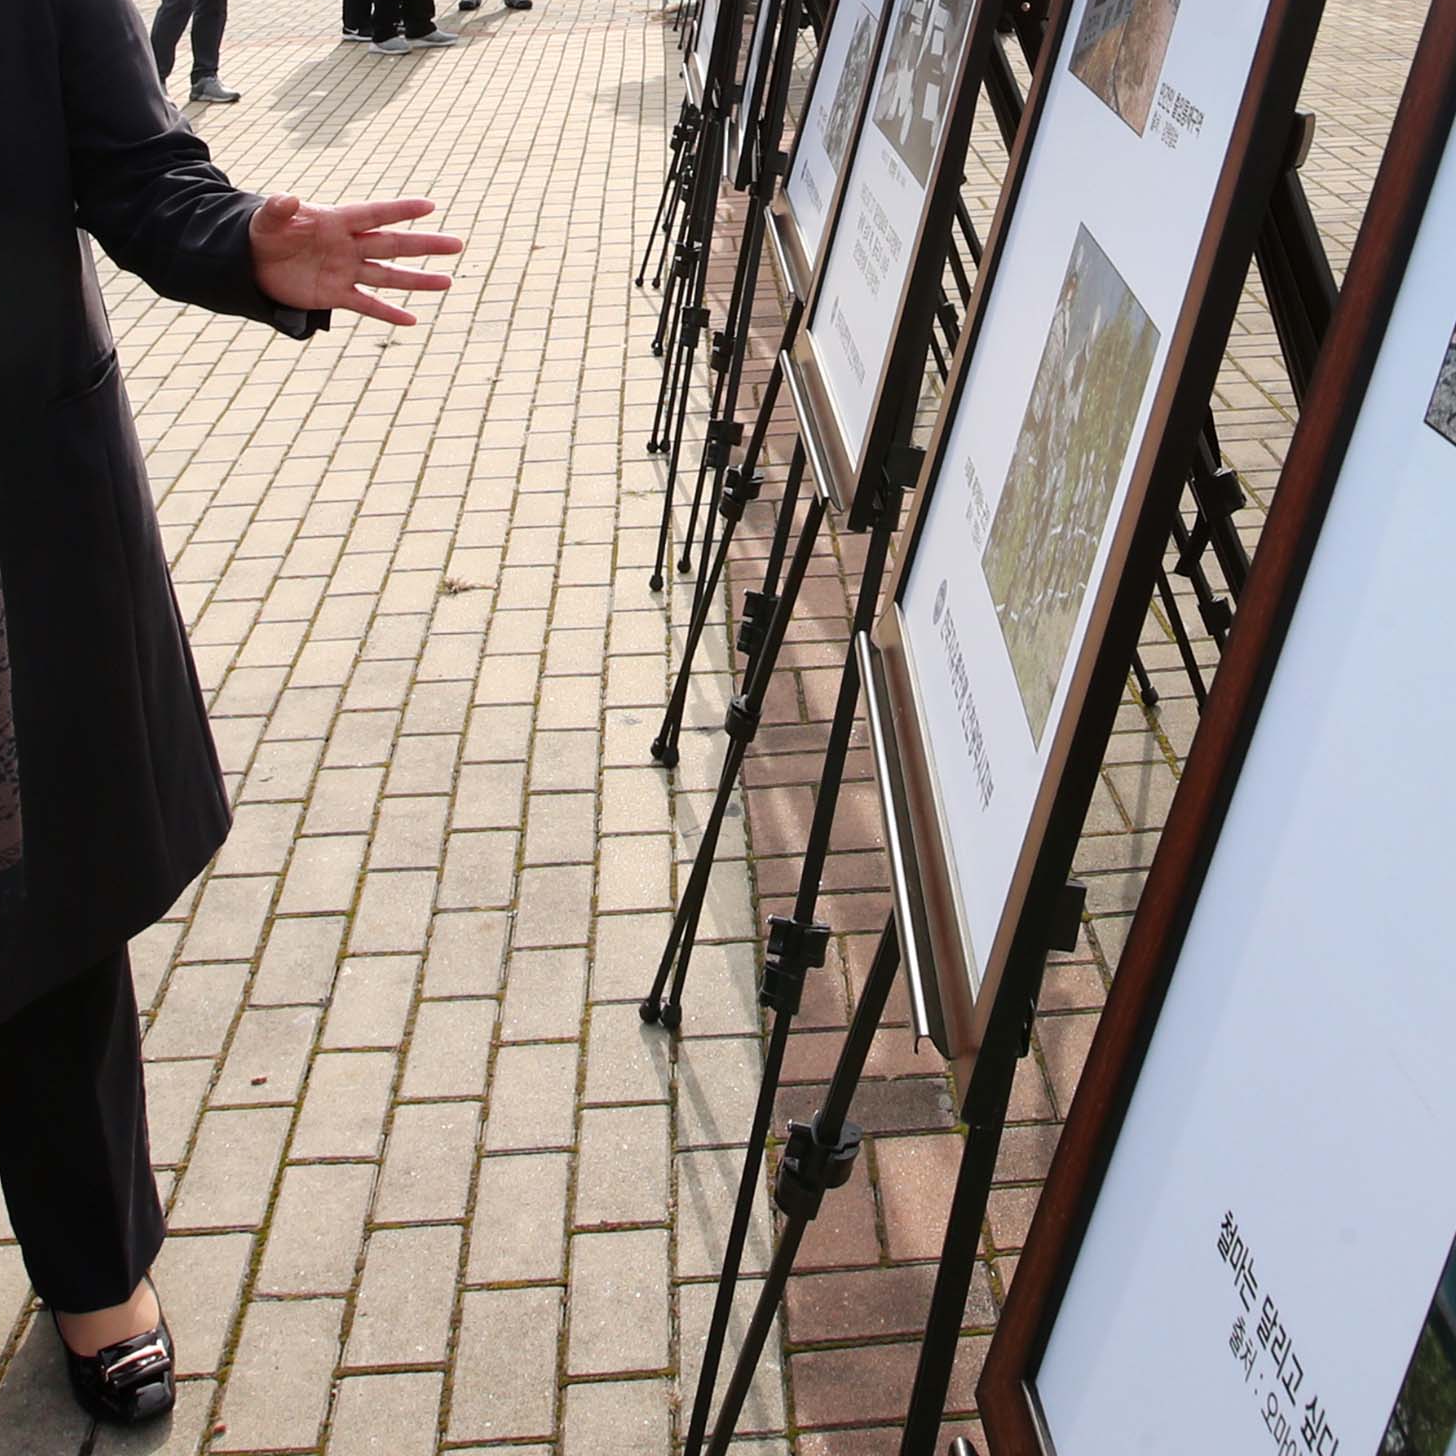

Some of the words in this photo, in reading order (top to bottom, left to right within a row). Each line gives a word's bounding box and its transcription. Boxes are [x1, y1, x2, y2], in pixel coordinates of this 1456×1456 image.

[1217, 1209, 1258, 1313] 철마는
[1256, 1294, 1304, 1407] 달리고
[1228, 1316, 1258, 1383] 출처
